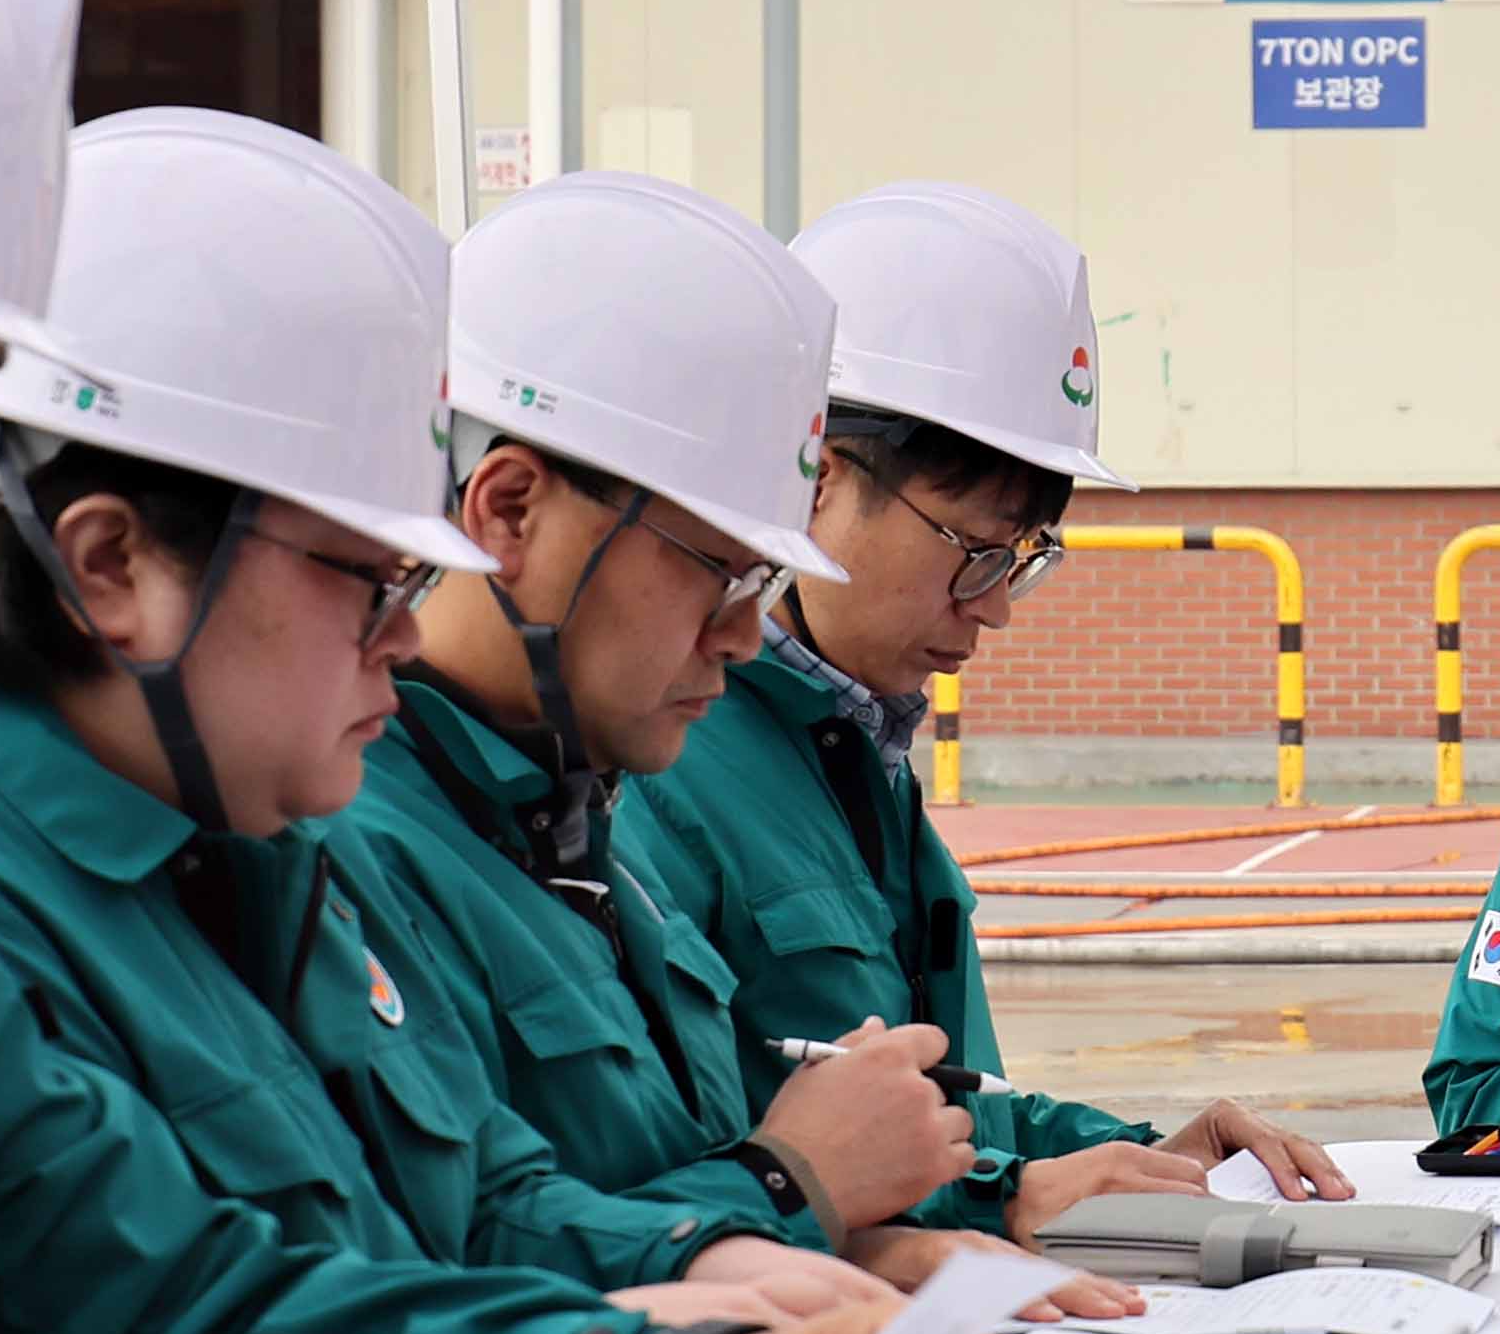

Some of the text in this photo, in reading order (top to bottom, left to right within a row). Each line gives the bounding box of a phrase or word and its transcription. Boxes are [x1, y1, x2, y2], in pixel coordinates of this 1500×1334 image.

[1258, 36, 1419, 66] 7TON OPC
[1293, 77, 1383, 110] 보관장
